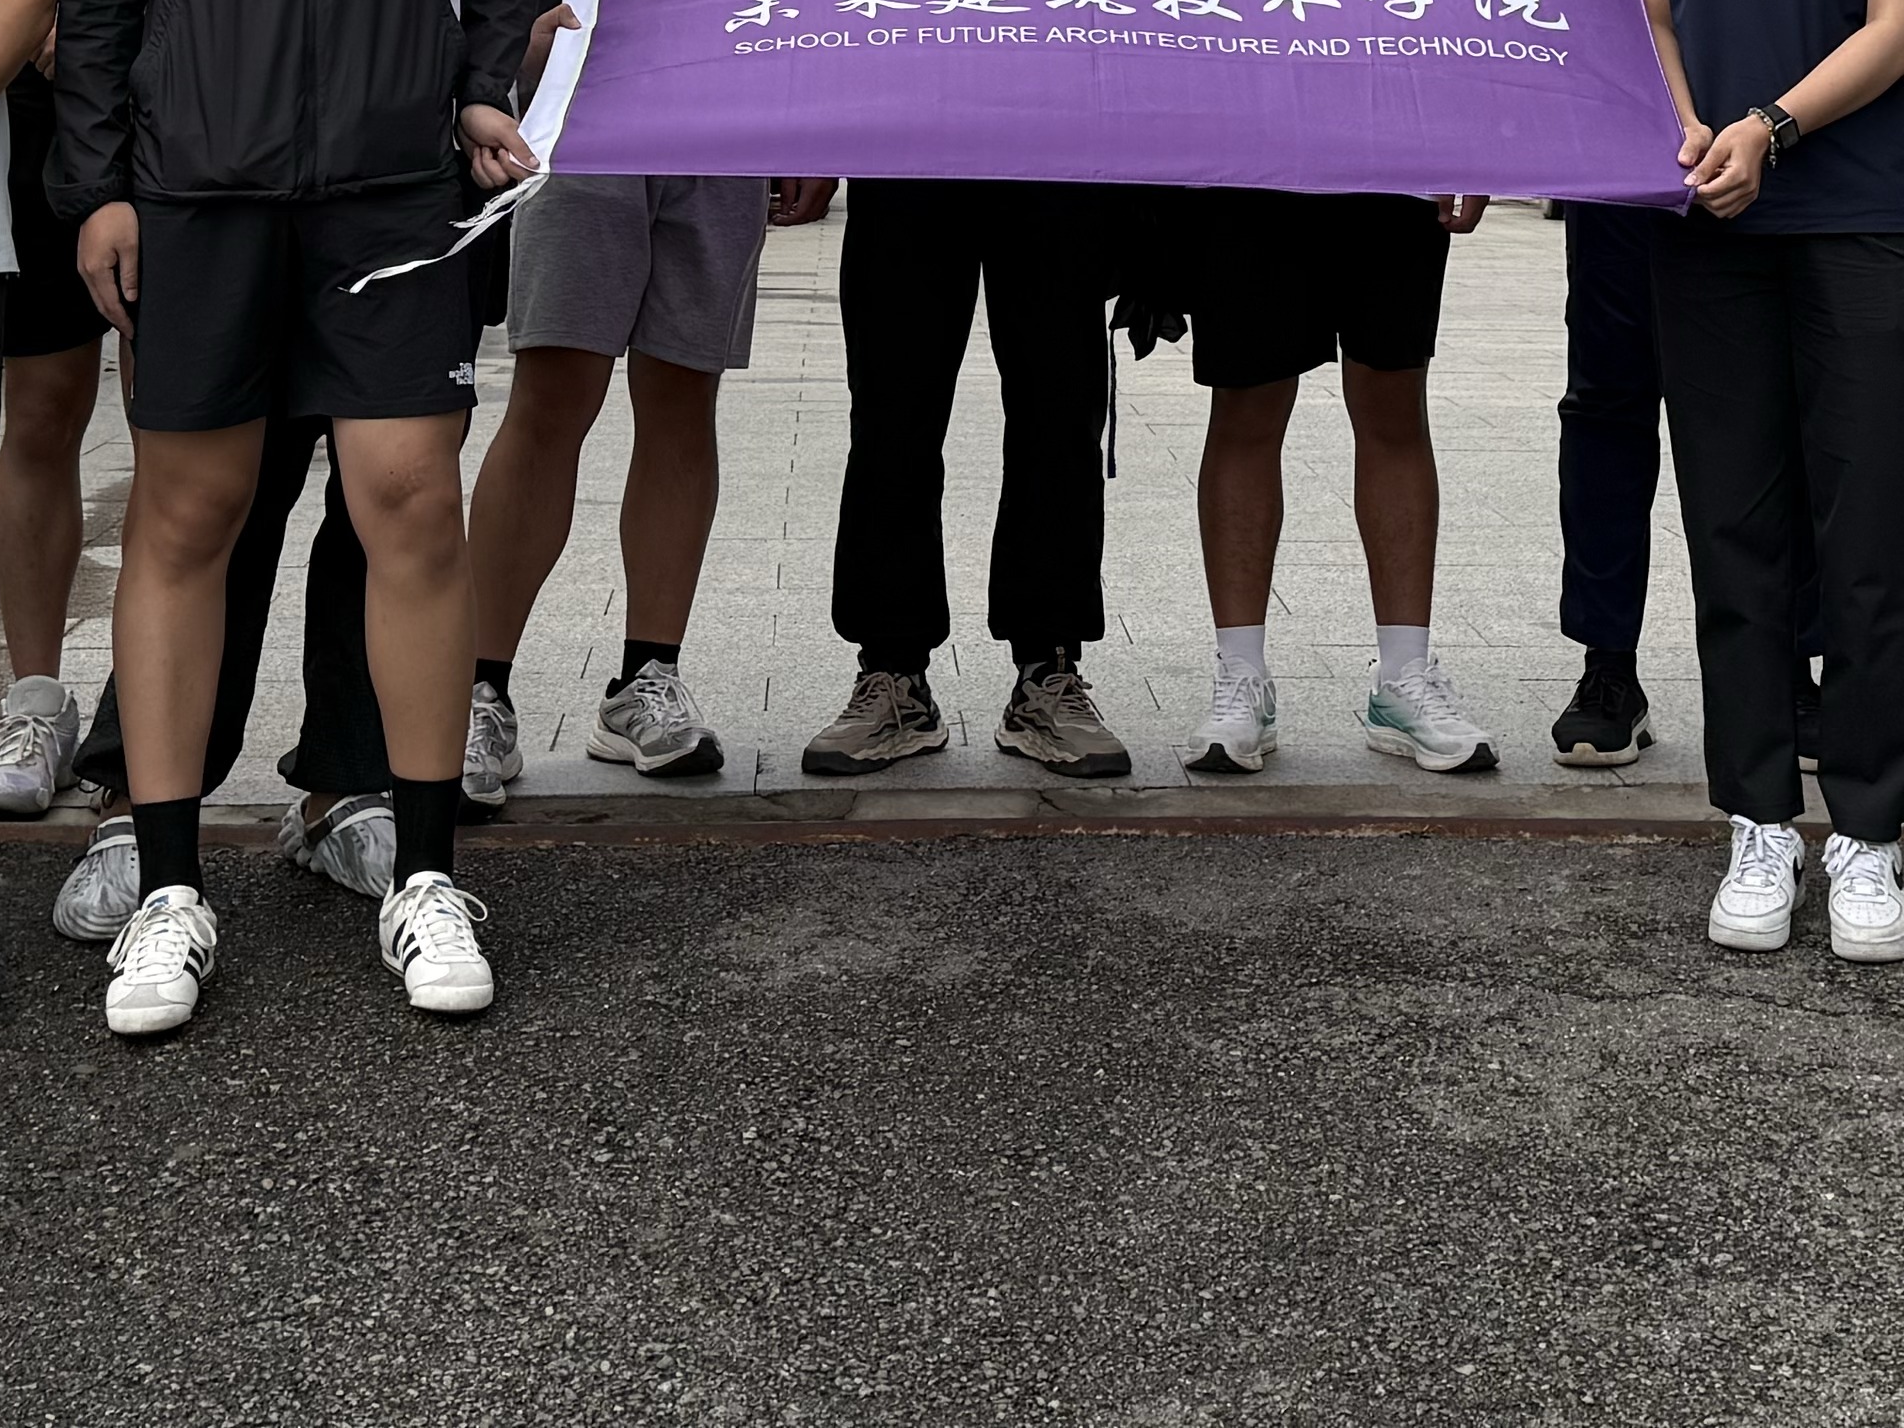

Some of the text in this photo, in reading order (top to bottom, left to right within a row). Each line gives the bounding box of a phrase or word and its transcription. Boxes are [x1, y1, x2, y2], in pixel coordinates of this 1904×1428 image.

[733, 26, 1569, 66] SCHOOL OF FUTURE ARCHITECTURE AND TECHNOLOGY
